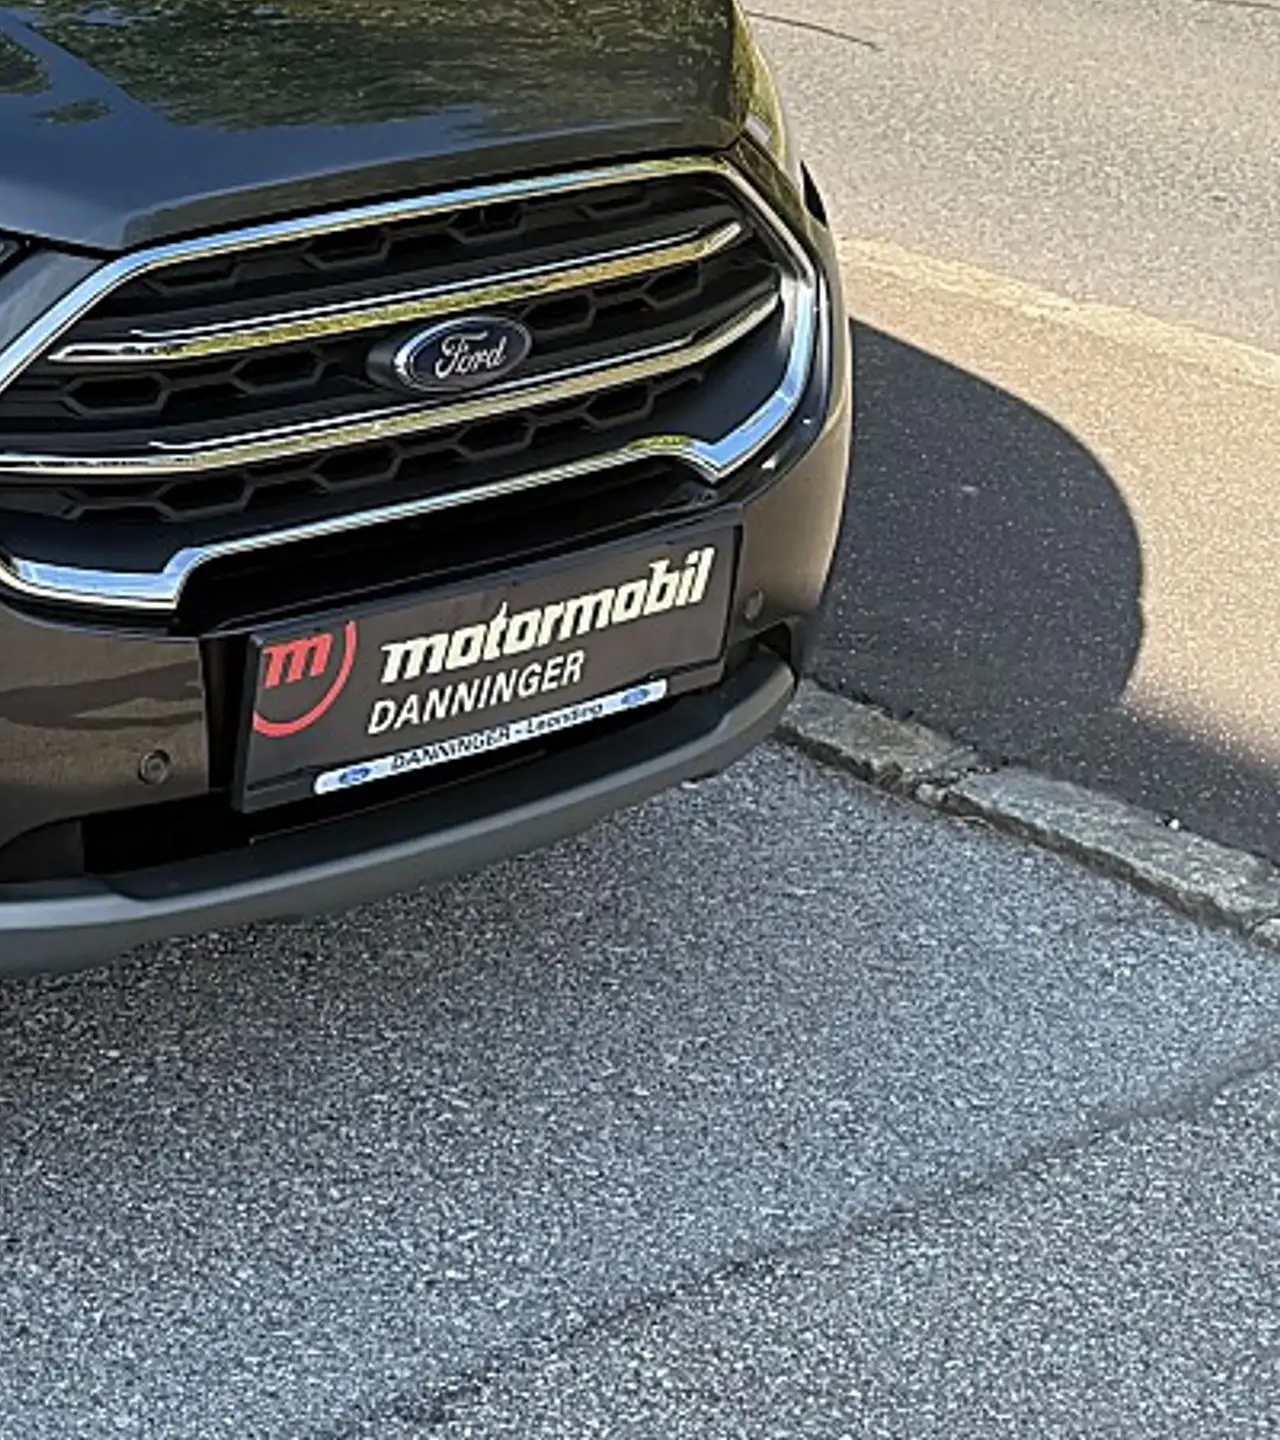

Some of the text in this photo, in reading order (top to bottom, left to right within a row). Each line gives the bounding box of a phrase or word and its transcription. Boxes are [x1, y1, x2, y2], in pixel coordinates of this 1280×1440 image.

[435, 330, 508, 379] Ford
[380, 546, 715, 683] motormobil
[367, 649, 585, 735] DANNINGER
[391, 725, 511, 770] DANNINGER
